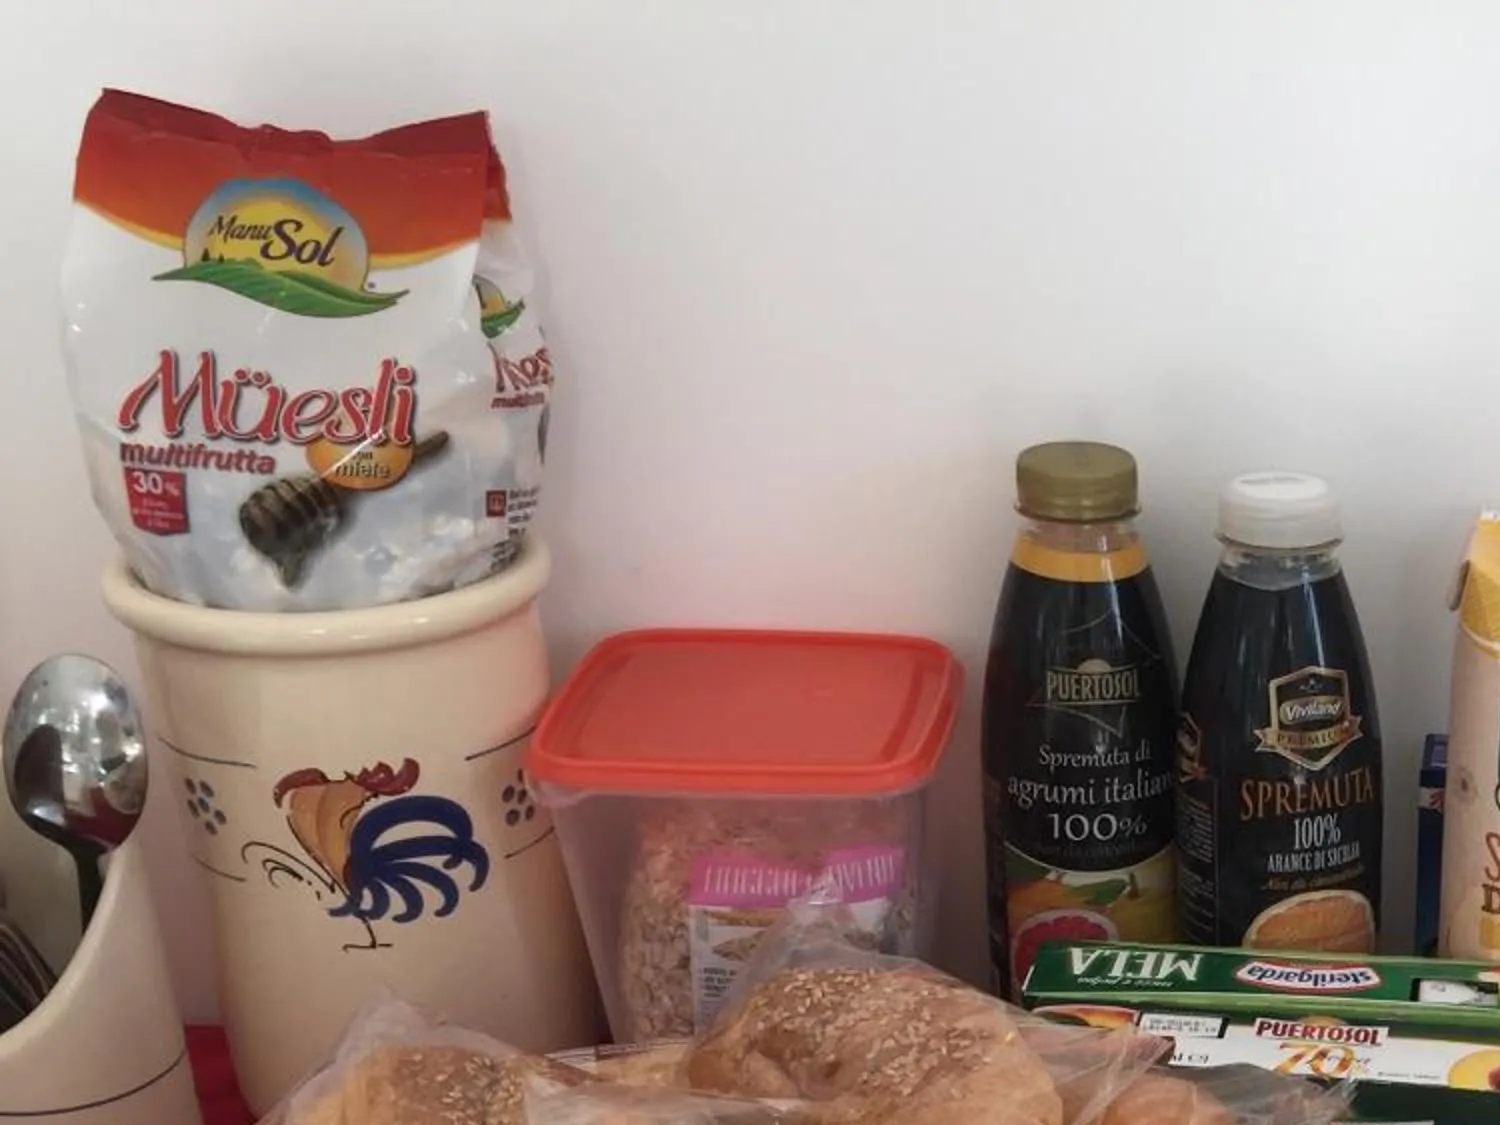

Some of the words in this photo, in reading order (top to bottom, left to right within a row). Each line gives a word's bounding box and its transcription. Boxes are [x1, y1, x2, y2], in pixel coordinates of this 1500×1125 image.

[207, 215, 273, 241] Manu
[260, 218, 343, 267] Sol
[117, 348, 417, 445] Müesli
[120, 441, 277, 475] multifrutta
[1047, 669, 1140, 701] PUERTOSOL
[1039, 744, 1131, 773] Spremuta
[1008, 774, 1096, 809] agrumi
[1239, 765, 1376, 822] SPREMUTA
[1294, 813, 1341, 851] 100%
[1068, 947, 1205, 982] MELA
[1246, 963, 1373, 987] sterilgarda
[1256, 1021, 1382, 1046] PUERTOSOL
